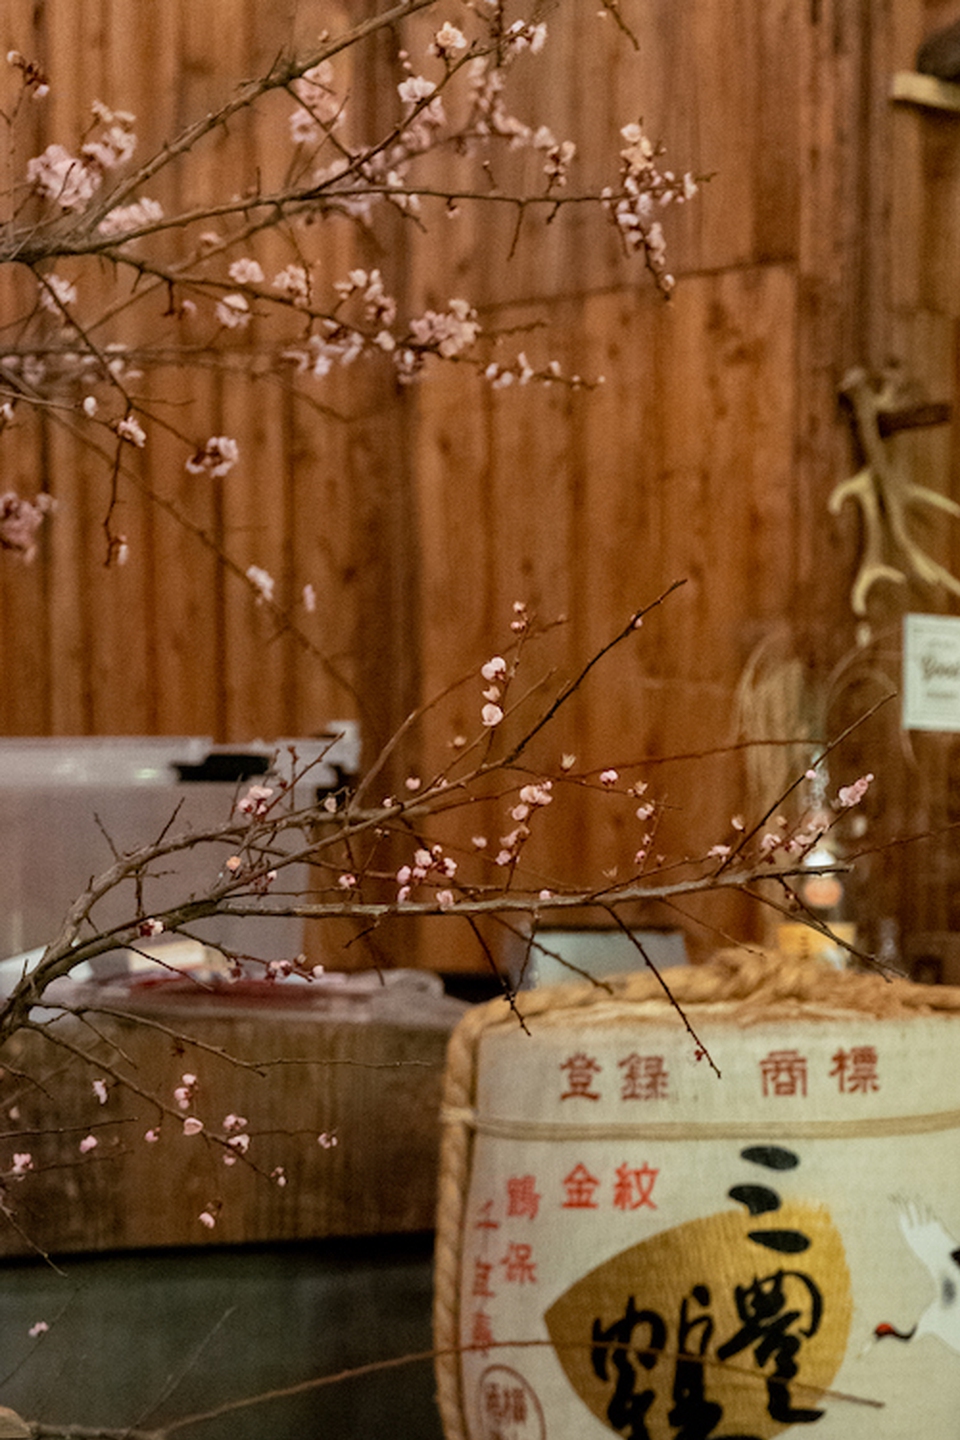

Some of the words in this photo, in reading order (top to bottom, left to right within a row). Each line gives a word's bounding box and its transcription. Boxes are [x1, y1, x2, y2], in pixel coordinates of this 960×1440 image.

[560, 1052, 670, 1101] 登録
[759, 1046, 880, 1098] 商標
[561, 1163, 660, 1211] 金紋
